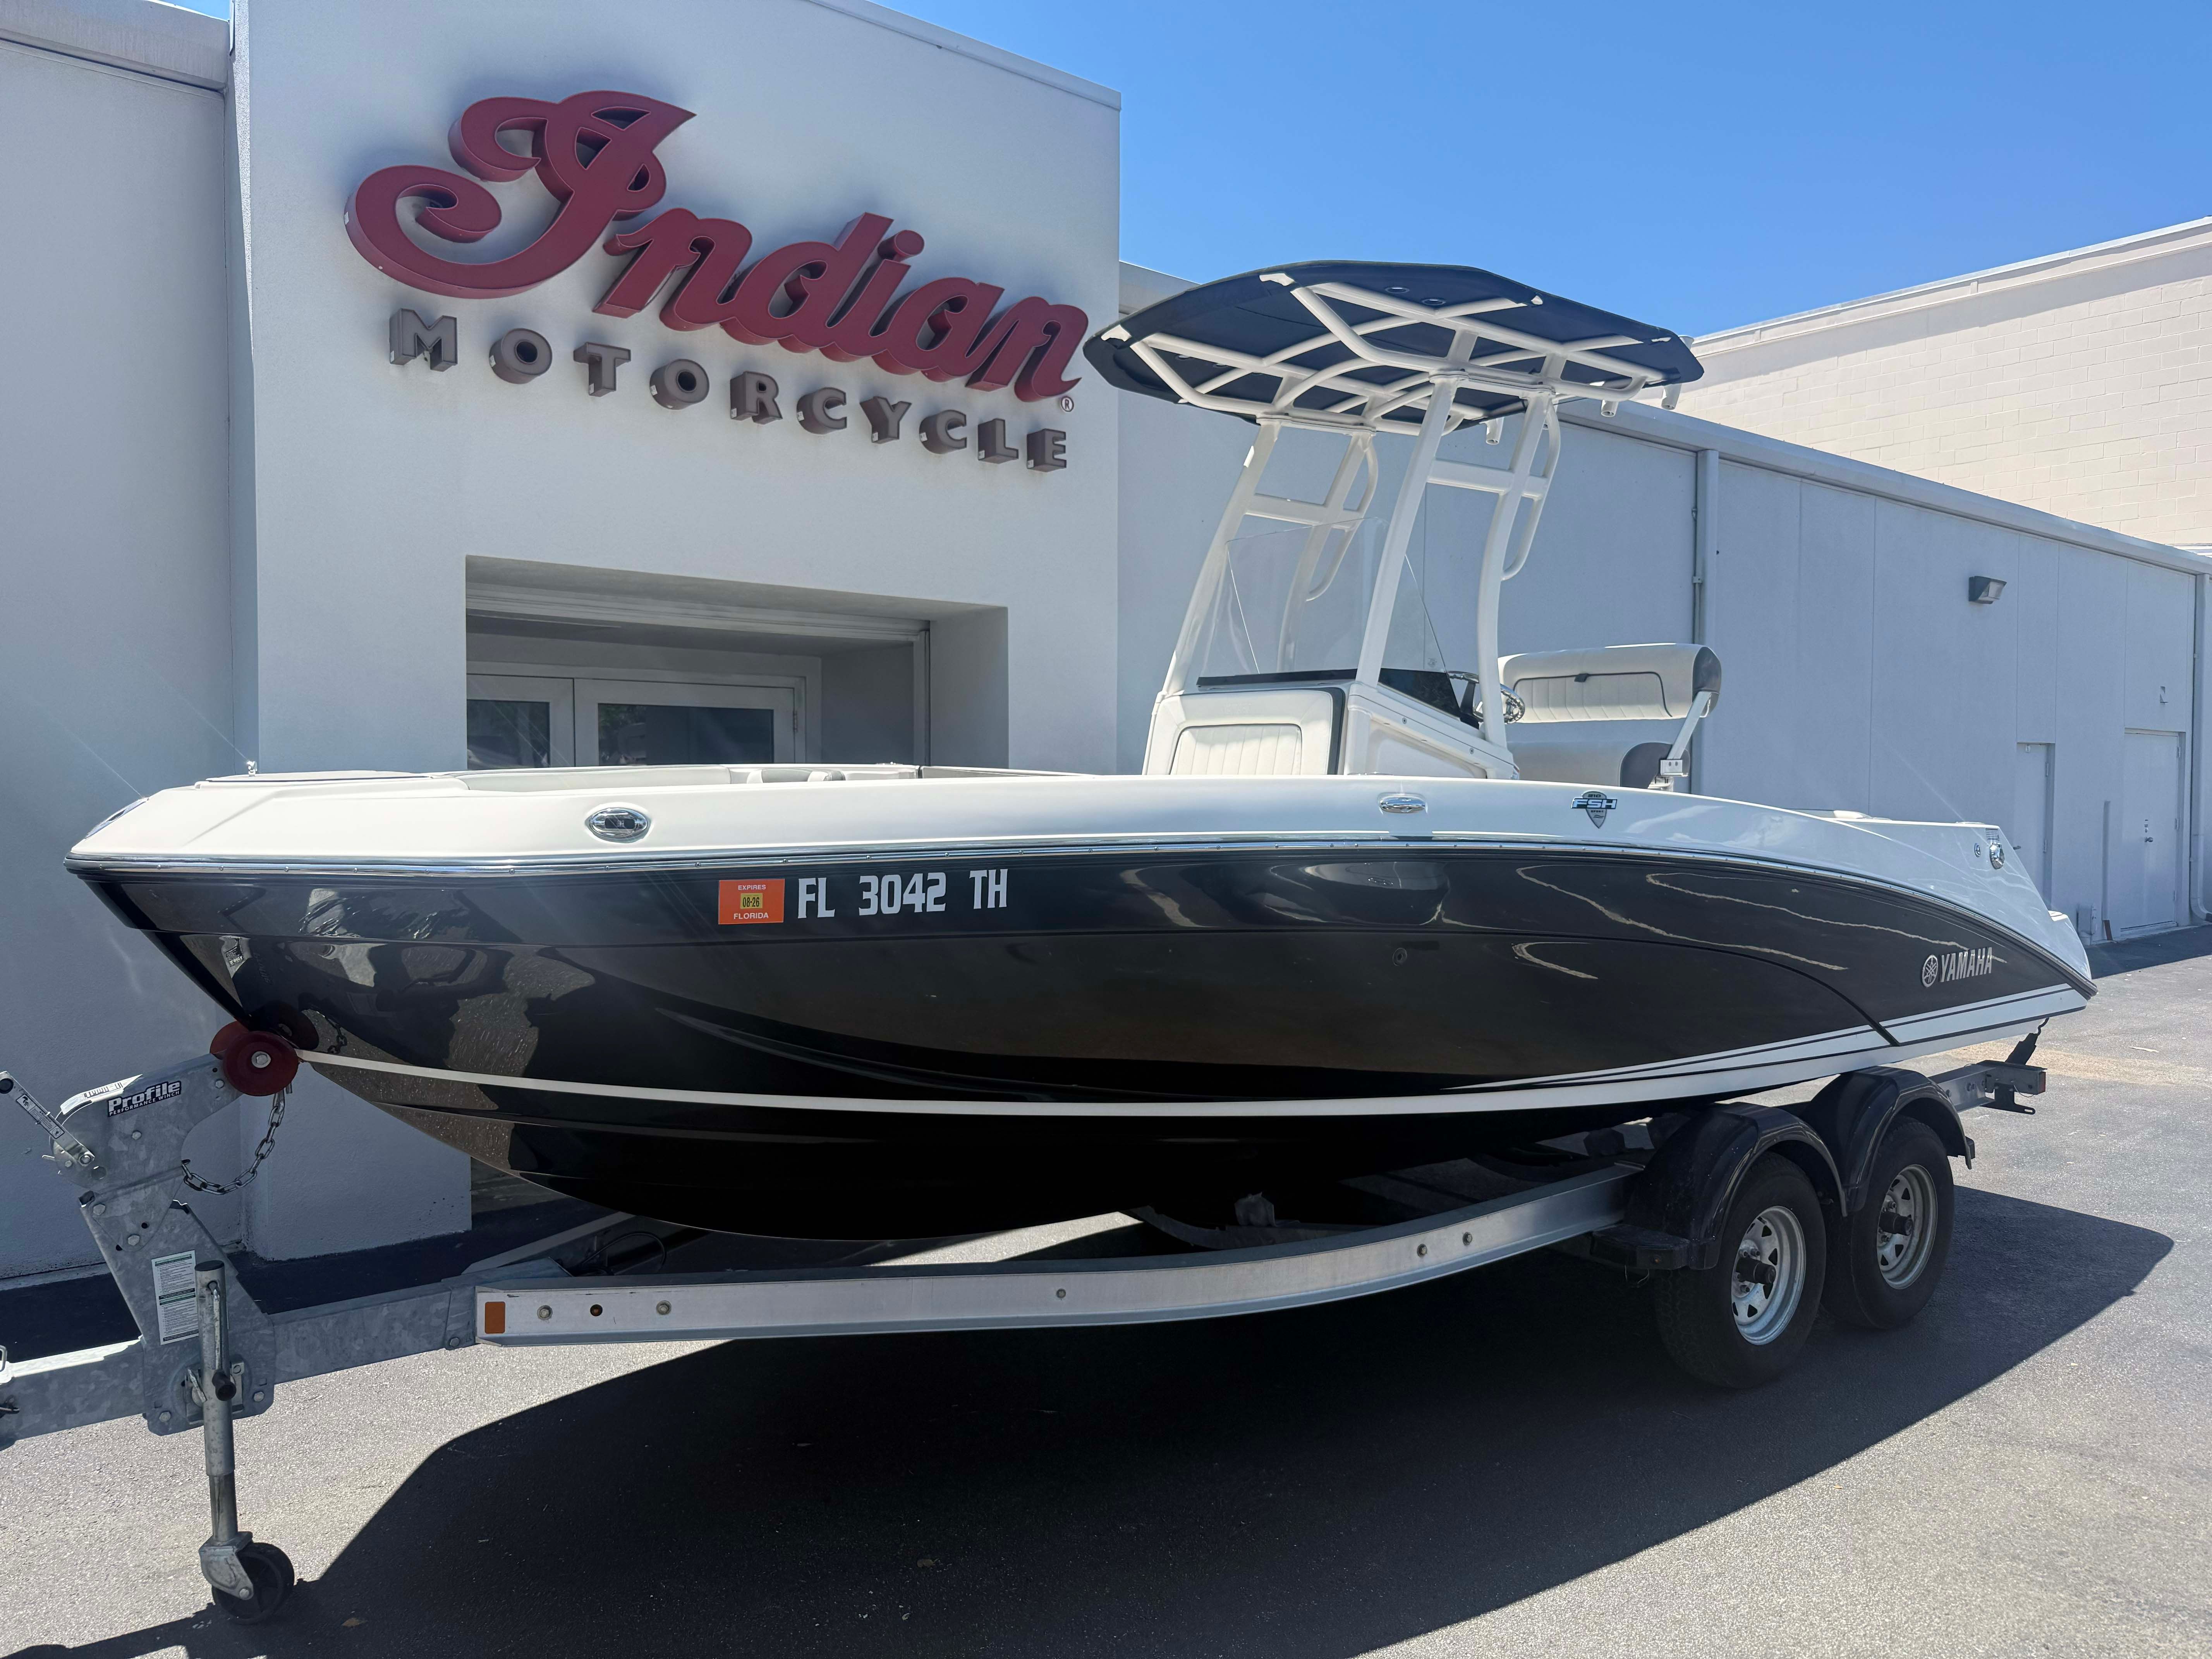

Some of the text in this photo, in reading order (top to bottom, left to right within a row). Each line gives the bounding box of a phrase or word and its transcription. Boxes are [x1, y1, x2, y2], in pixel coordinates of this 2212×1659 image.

[343, 90, 1089, 403] Indian
[389, 308, 1067, 472] MOTORCYCLE
[1572, 799, 1617, 808] FSH
[798, 869, 1008, 919] FL 3042 TH
[1939, 947, 1992, 982] YAMAHA
[109, 1082, 180, 1112] Profile
[110, 1091, 179, 1116] PERFORMANCE WINCH
